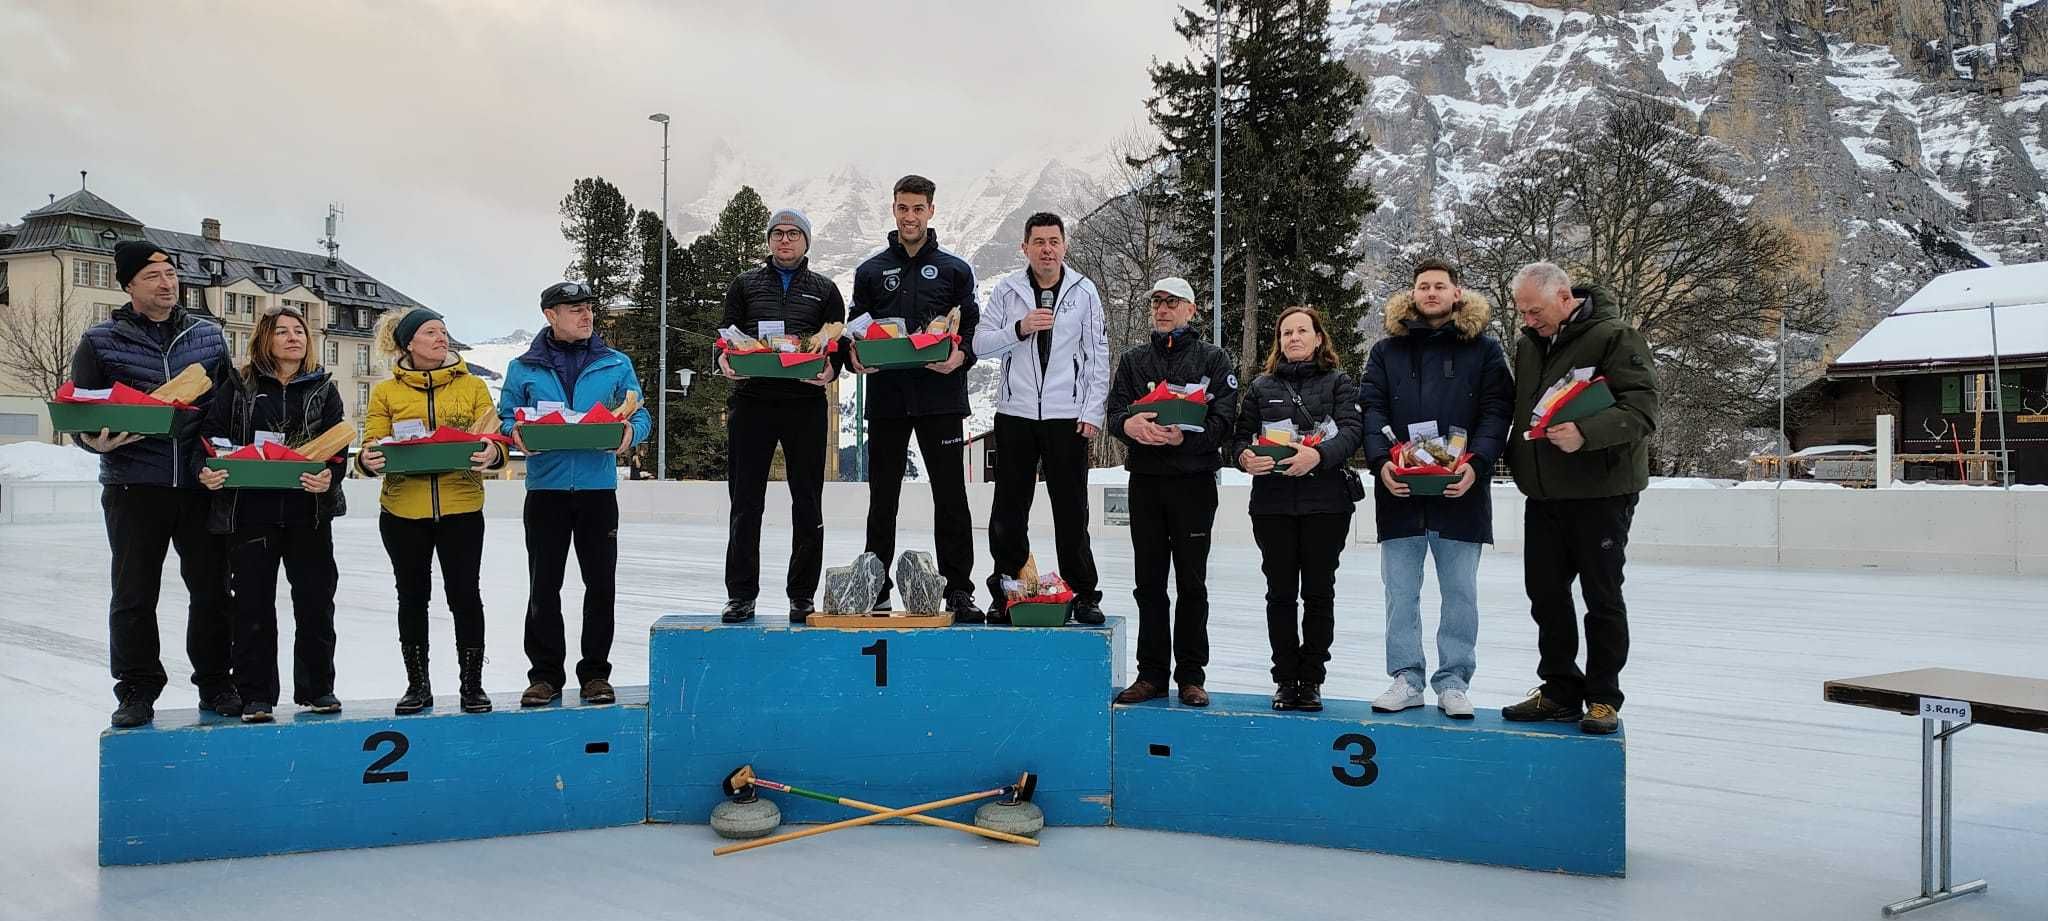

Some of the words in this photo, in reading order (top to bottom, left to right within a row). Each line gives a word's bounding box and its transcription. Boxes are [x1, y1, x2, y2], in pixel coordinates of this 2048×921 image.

[862, 639, 887, 687] 1
[1925, 703, 1966, 718] 3.Rang
[363, 730, 409, 784] 2
[1332, 733, 1379, 787] 3
